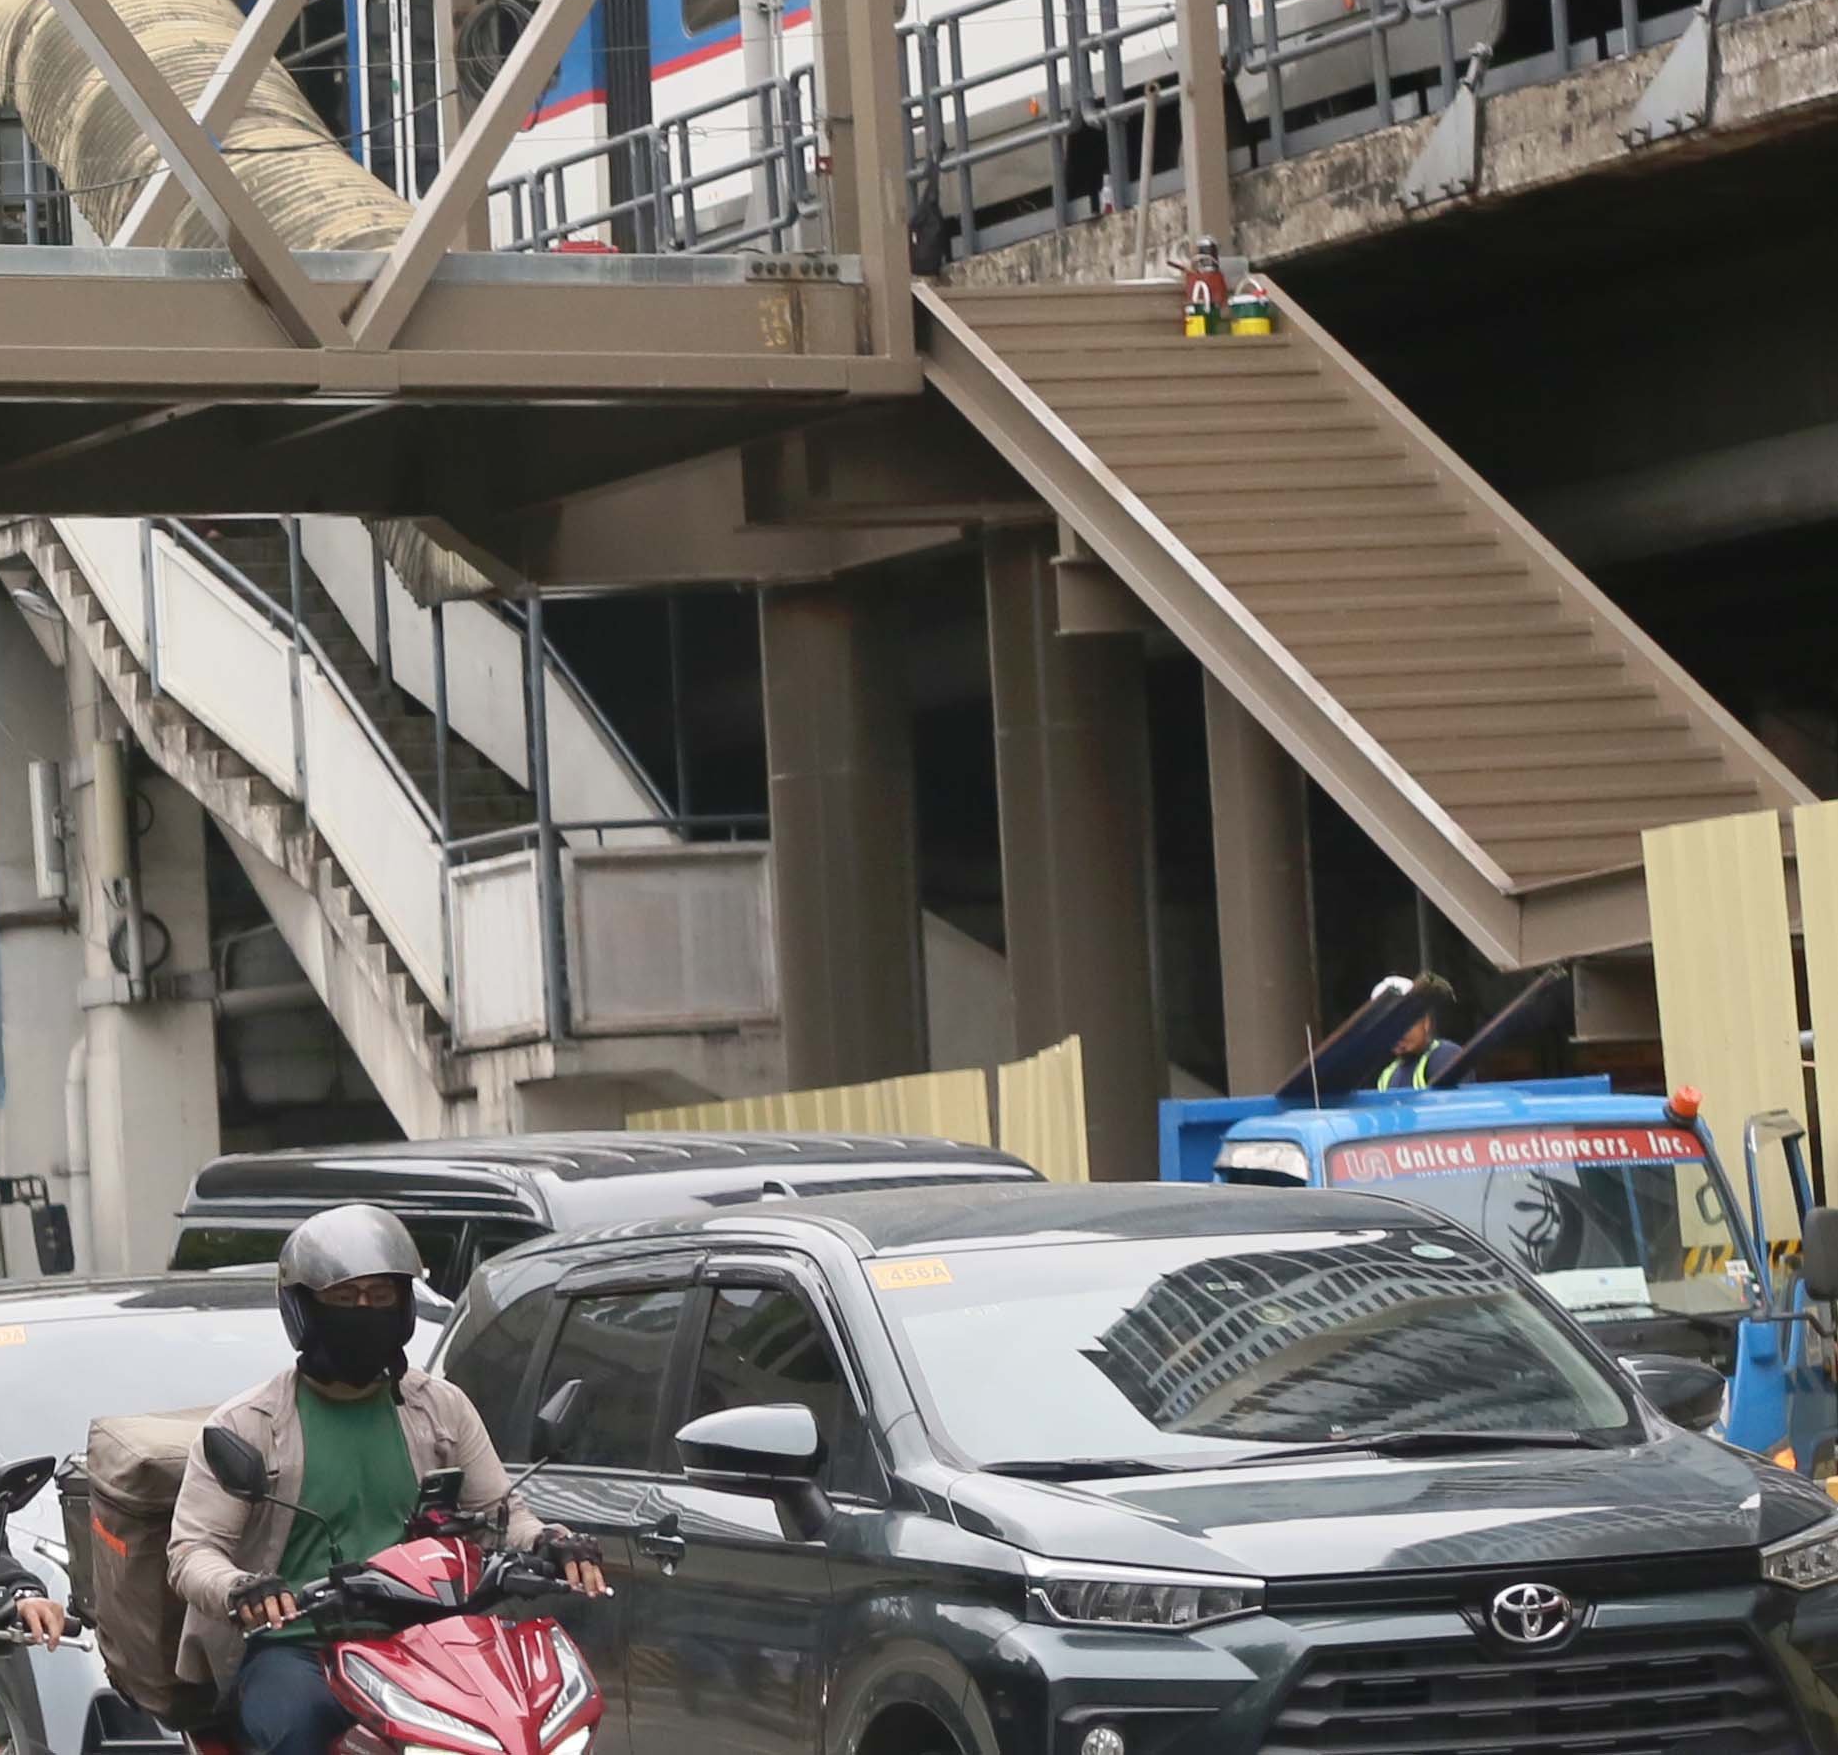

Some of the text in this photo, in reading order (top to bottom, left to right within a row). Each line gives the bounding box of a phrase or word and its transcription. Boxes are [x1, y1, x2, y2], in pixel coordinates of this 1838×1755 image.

[1396, 1140, 1475, 1170] United
[1488, 1131, 1638, 1161] Auctioneers,
[1647, 1129, 1692, 1155] Inc.
